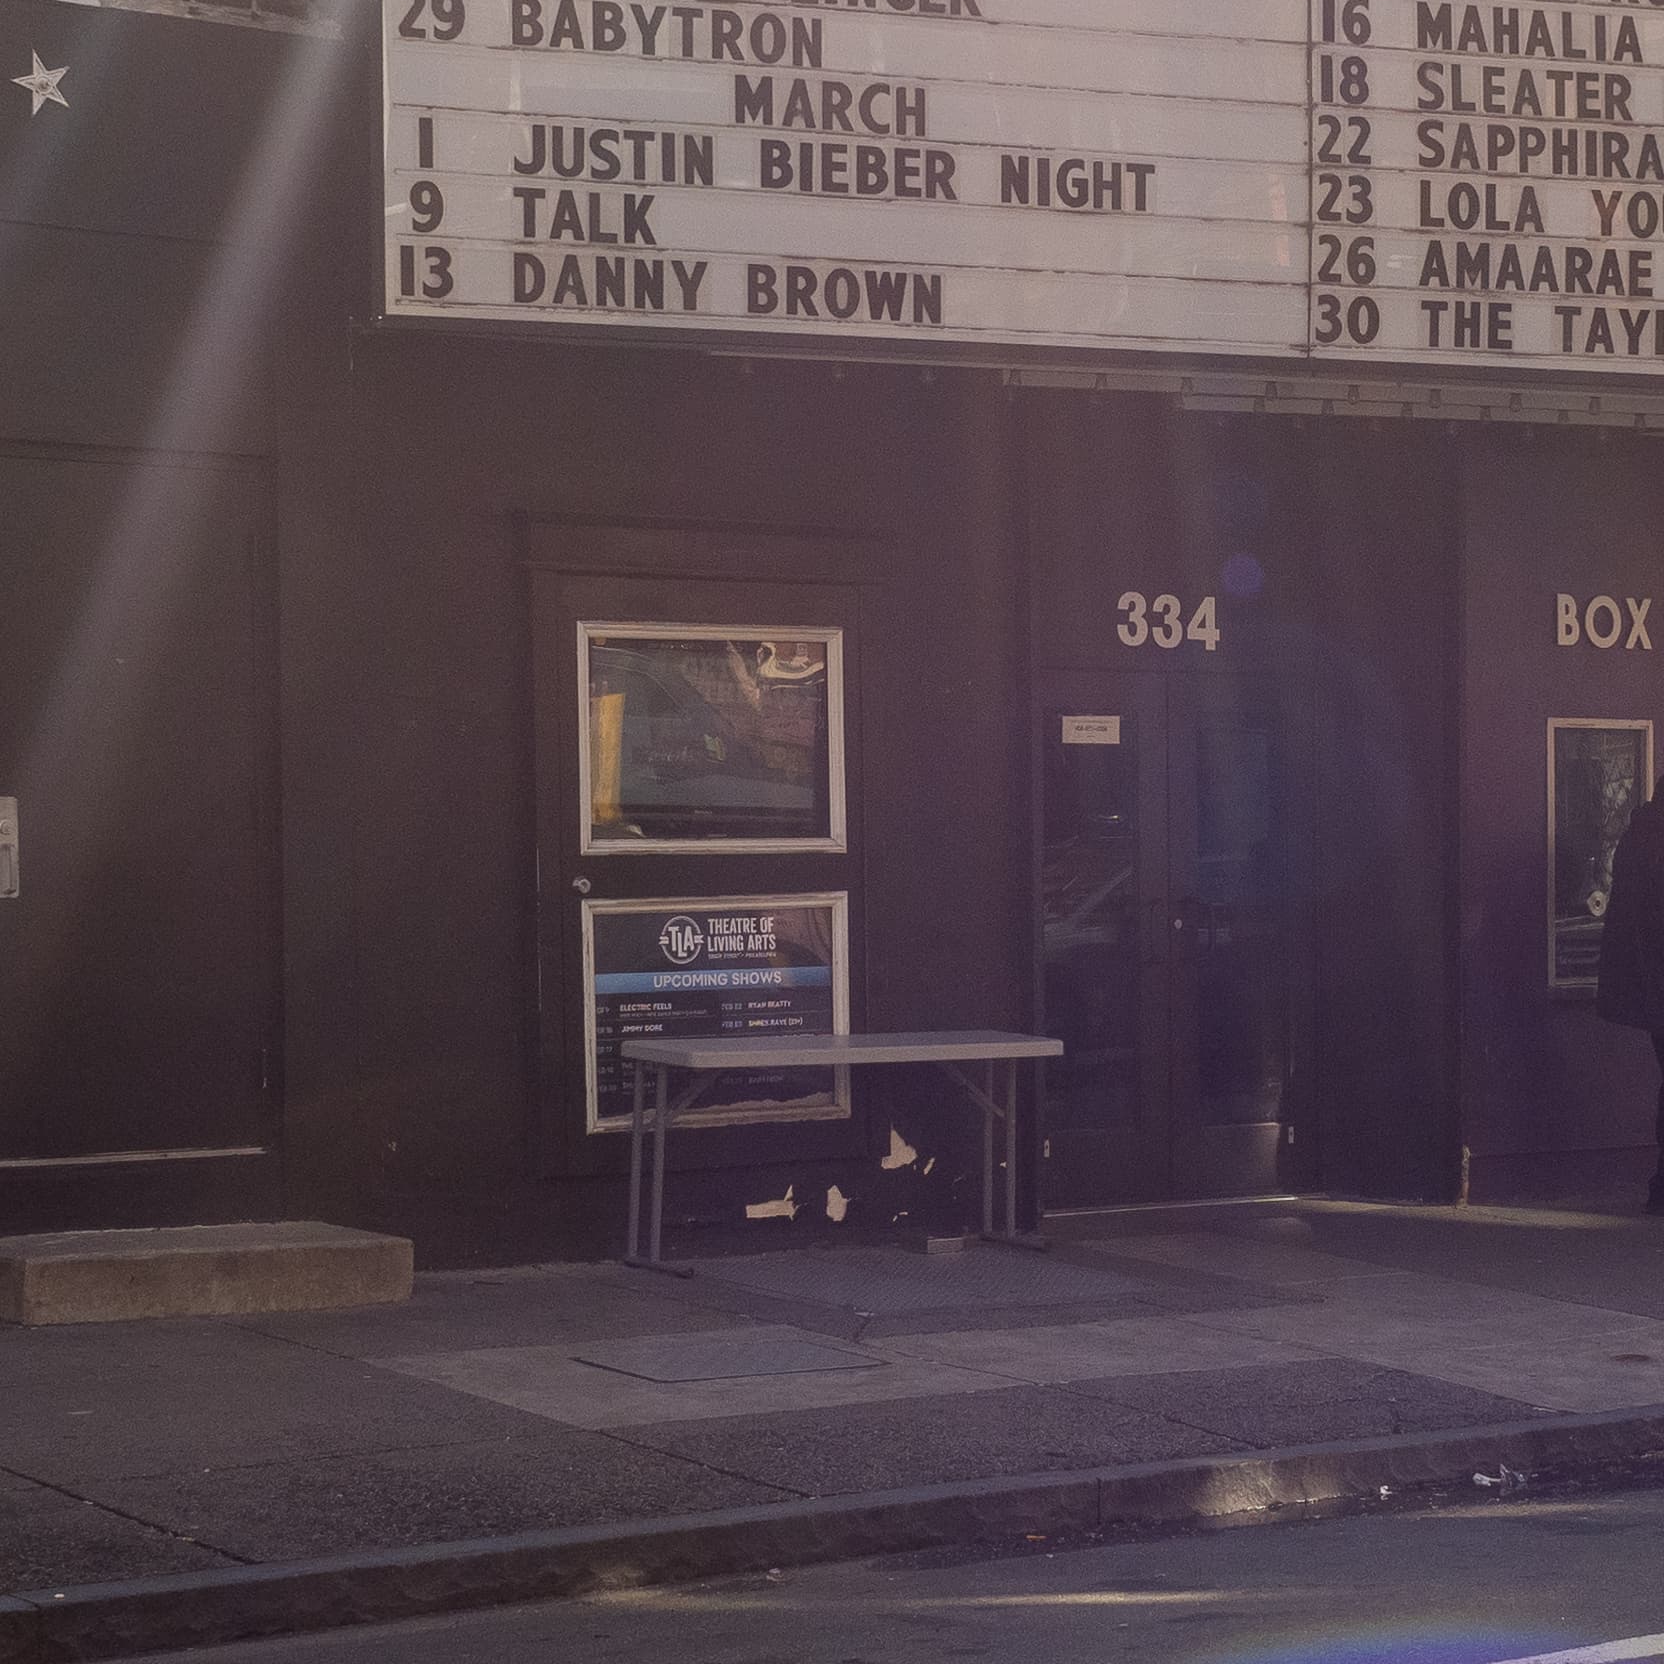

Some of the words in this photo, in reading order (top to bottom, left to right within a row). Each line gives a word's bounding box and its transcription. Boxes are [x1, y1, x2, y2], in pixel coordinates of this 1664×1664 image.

[1416, 1, 1643, 62] MAHALIA
[734, 74, 926, 136] MARCH
[1321, 56, 1368, 104] 18
[1417, 62, 1632, 122] SLEATER
[419, 117, 434, 170] 1
[513, 123, 715, 186] JUSTIN
[760, 140, 958, 200] BIEBER
[1001, 157, 1155, 212] NIGHT
[1317, 116, 1371, 164] 22
[1417, 120, 1664, 180] SAPPHIRA
[409, 180, 444, 233] 9
[514, 186, 657, 245] TALK
[1317, 175, 1372, 223] 23
[1420, 180, 1544, 233] LOLA
[399, 245, 454, 299] 13
[513, 252, 708, 311] DANNY
[748, 265, 943, 324] BROWN
[1318, 235, 1376, 284] 26
[1419, 240, 1653, 297] AMAARAE
[1315, 294, 1380, 344] 30
[1421, 301, 1512, 350] THE
[1117, 592, 1221, 651] 334
[1557, 593, 1653, 651] BOX
[668, 926, 695, 957] TLA
[707, 918, 758, 934] THEATRE
[759, 917, 775, 932] OF
[707, 936, 745, 952] LIVING
[747, 934, 777, 951] ARTS
[619, 1003, 652, 1012] ELECTRIC
[653, 974, 728, 989] UPCOMING
[731, 970, 783, 985] SHOWS
